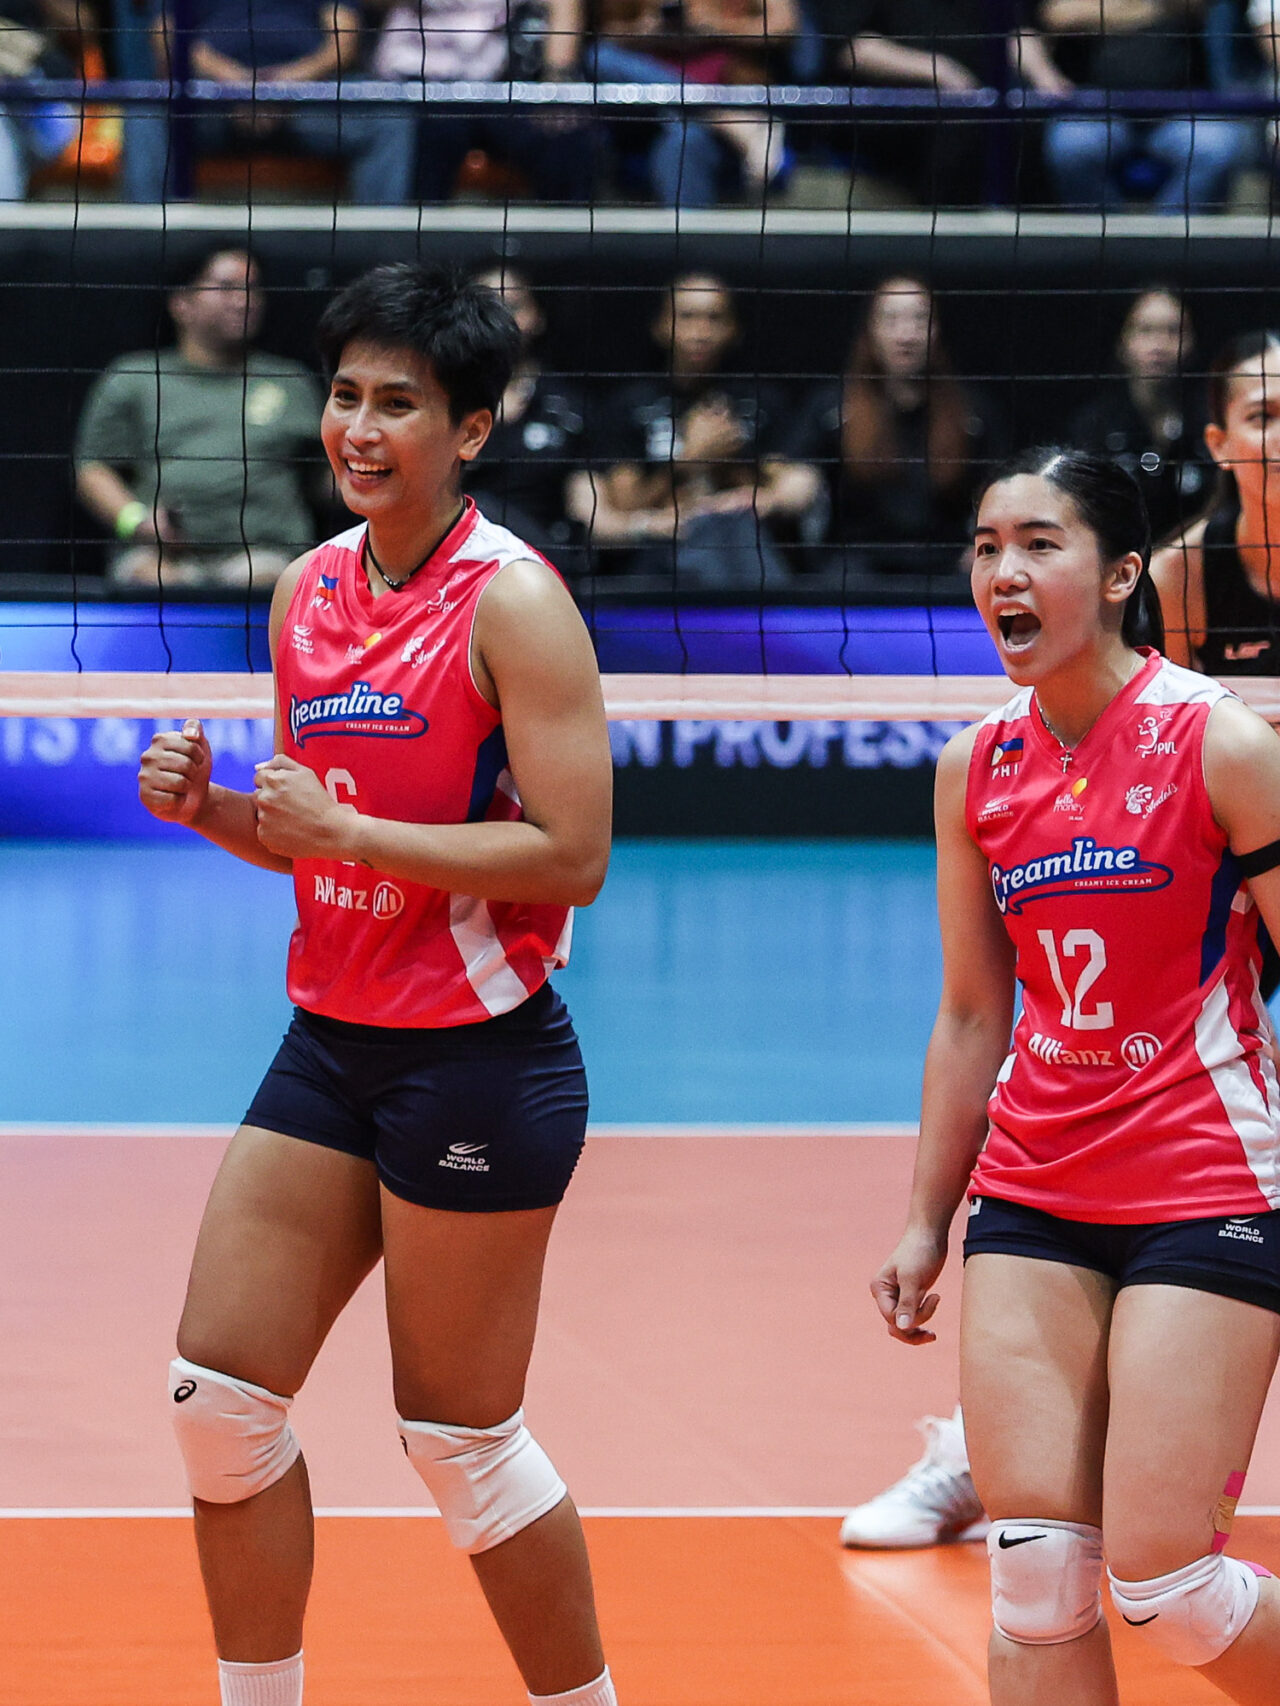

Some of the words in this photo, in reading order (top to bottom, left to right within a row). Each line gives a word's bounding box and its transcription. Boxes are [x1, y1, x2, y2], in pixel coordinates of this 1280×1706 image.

[1157, 742, 1178, 755] PVL
[991, 763, 1019, 780] PHI
[992, 840, 1136, 913] Creamline
[1074, 879, 1103, 887] CREAMY
[1106, 879, 1120, 887] ICE
[1122, 878, 1152, 886] CREAM
[314, 875, 368, 910] Allianz
[1037, 929, 1114, 1030] 12
[1028, 1032, 1115, 1066] Allianz
[438, 1160, 490, 1172] BALANCE
[446, 1154, 486, 1165] WORLD
[1225, 1223, 1260, 1235] WORLD
[1218, 1230, 1264, 1244] BALANCE
